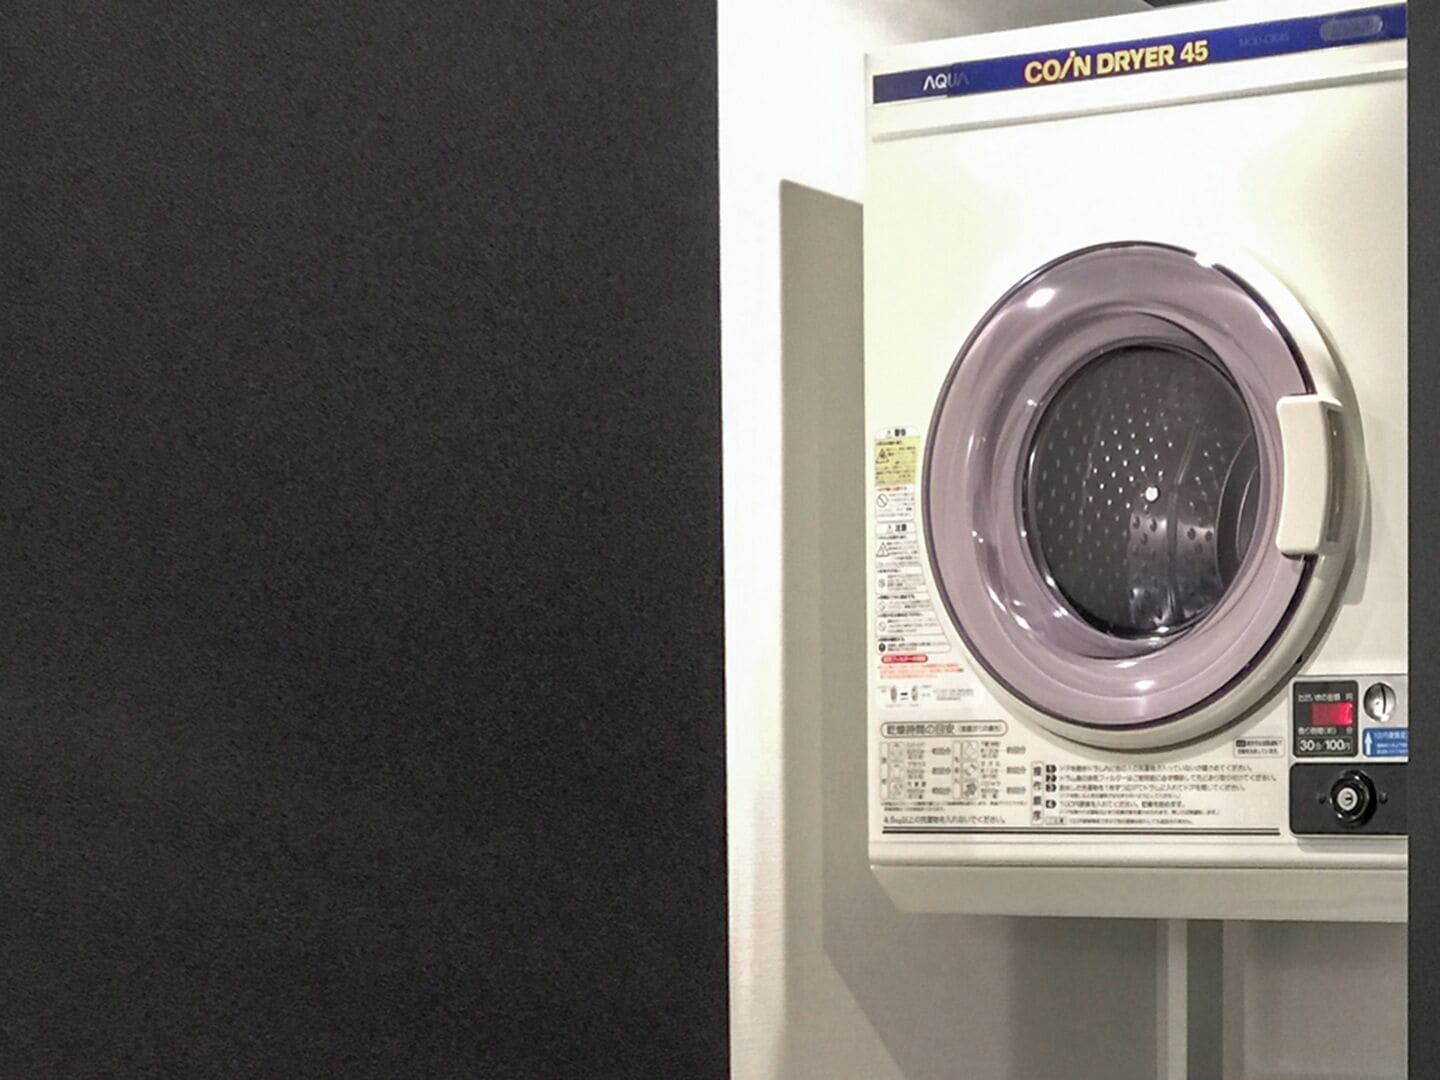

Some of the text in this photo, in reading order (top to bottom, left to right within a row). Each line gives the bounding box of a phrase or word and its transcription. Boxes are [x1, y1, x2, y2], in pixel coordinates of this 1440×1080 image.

[1024, 40, 1209, 85] COIN DRYER 45
[923, 72, 970, 91] AQUA
